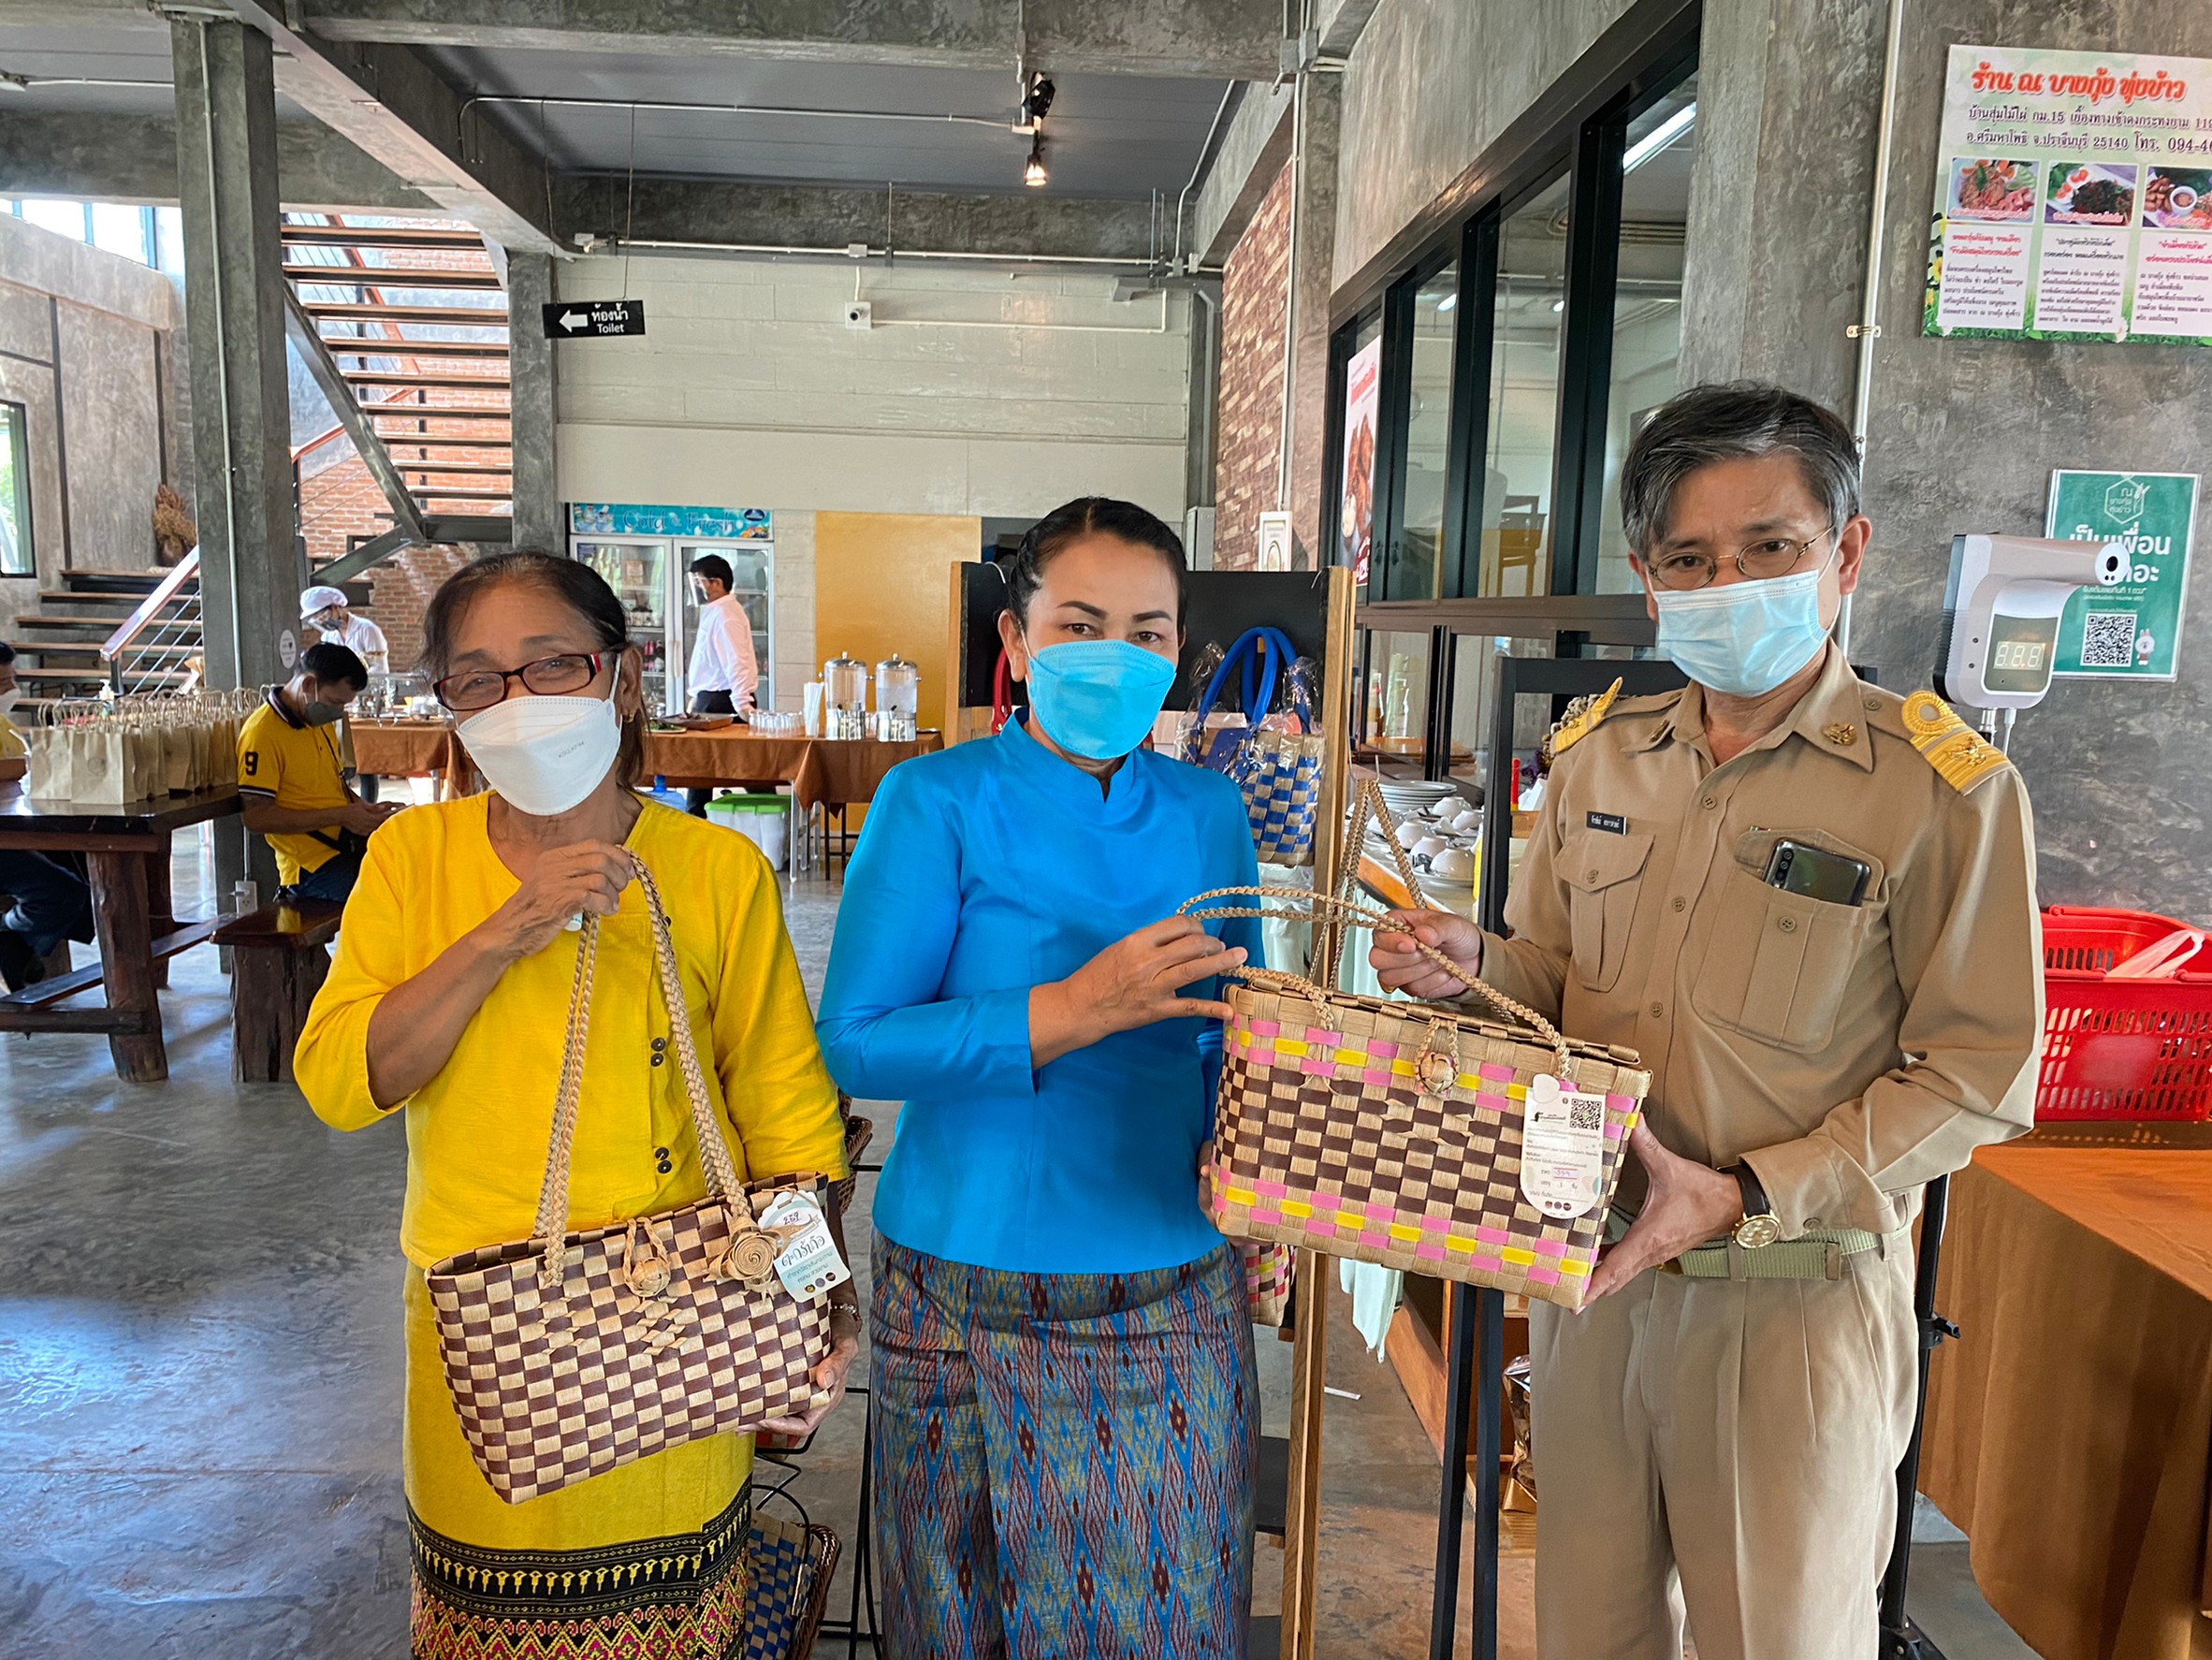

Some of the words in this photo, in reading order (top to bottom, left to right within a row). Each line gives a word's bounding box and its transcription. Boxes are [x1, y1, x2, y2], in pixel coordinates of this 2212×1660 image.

[1971, 62, 2013, 92] ร้าน
[2017, 74, 2043, 93] ณ
[2048, 67, 2116, 105] บางกุ้ง
[2119, 70, 2187, 107] ทุ่งข้าว
[2032, 109, 2065, 124] กม.15
[2093, 137, 2129, 149] 25140
[2134, 131, 2160, 151] โทร.
[591, 303, 629, 322] ห้องน้ำ
[596, 324, 624, 334] Toilet
[623, 509, 665, 531] Cold
[685, 511, 736, 531] Fresh
[244, 751, 259, 776] 9
